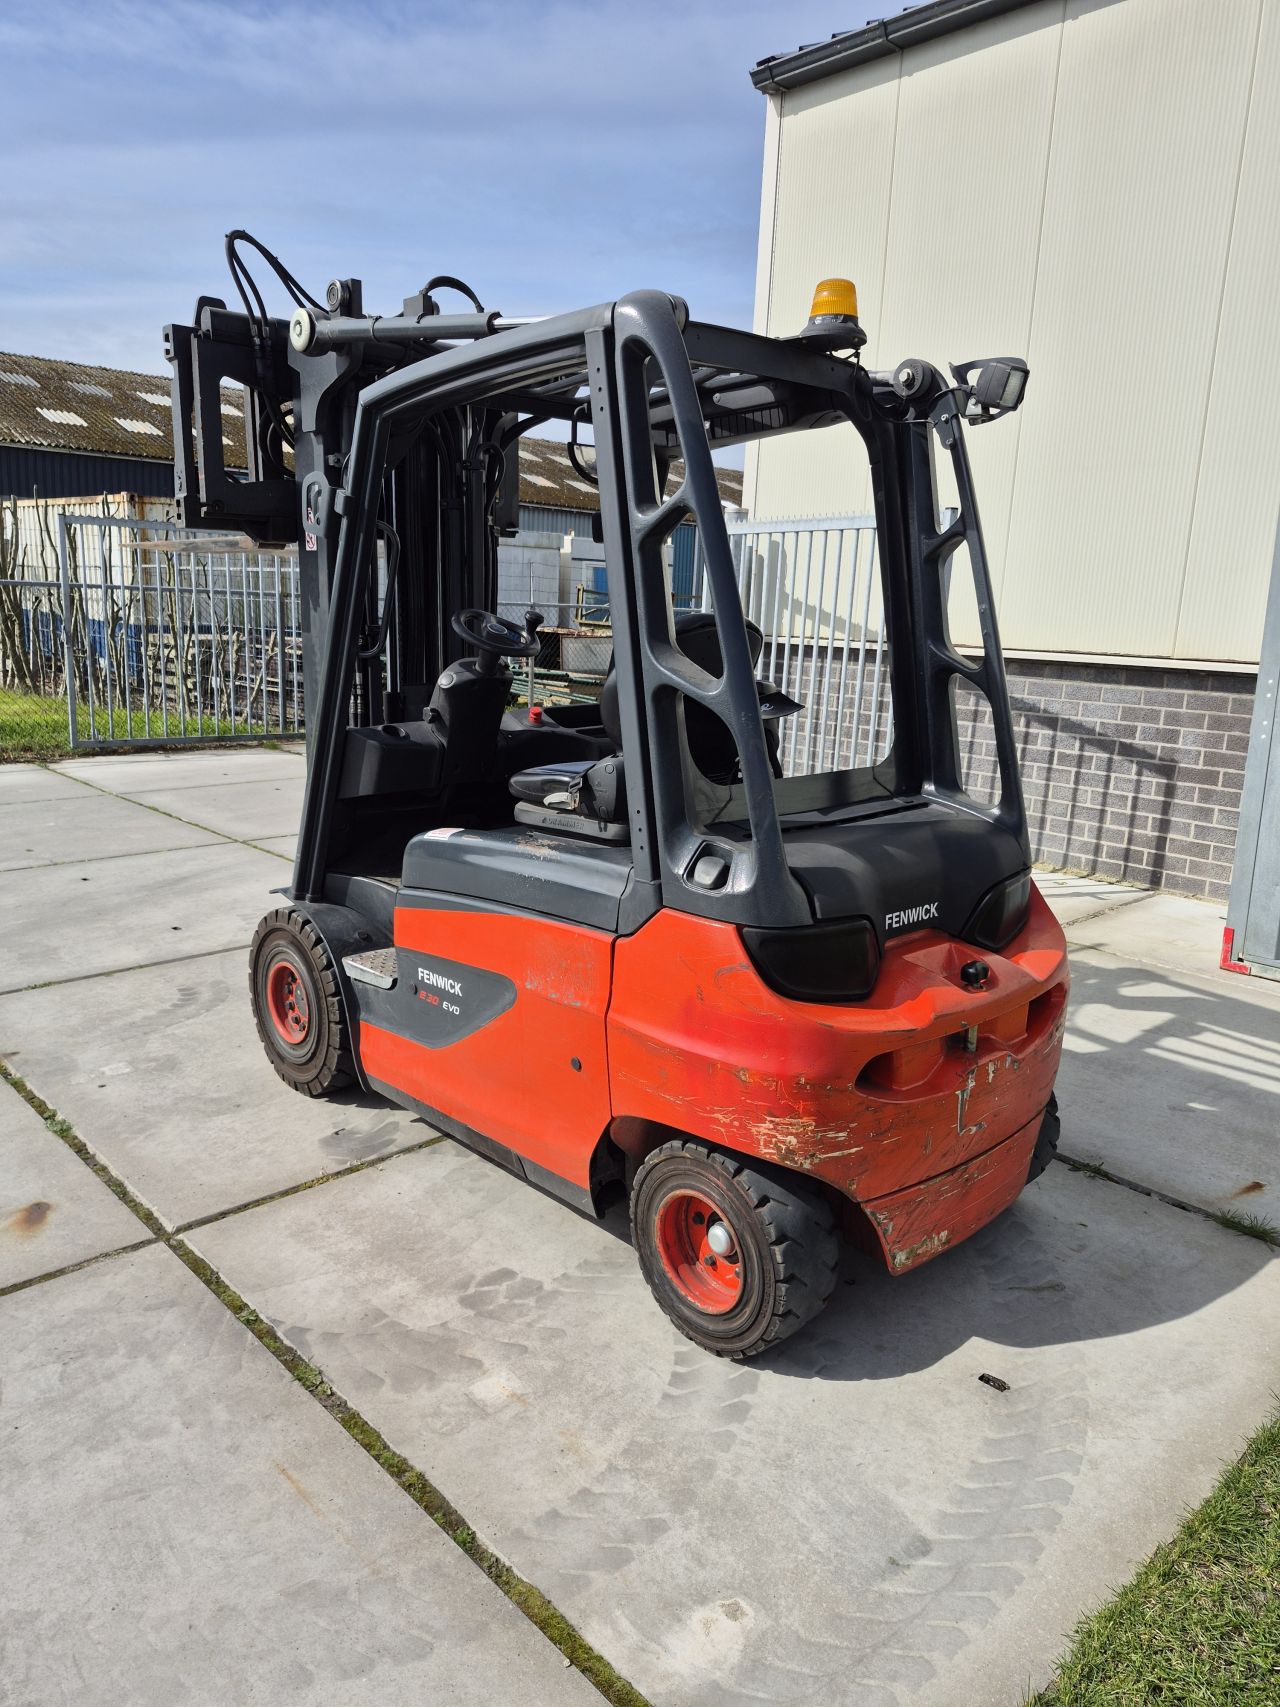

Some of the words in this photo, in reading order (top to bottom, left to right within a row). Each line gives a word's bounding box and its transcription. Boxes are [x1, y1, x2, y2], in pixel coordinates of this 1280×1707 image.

[885, 902, 939, 930] FENWICK
[417, 967, 463, 997] FENWICK
[442, 1001, 460, 1015] EVO
